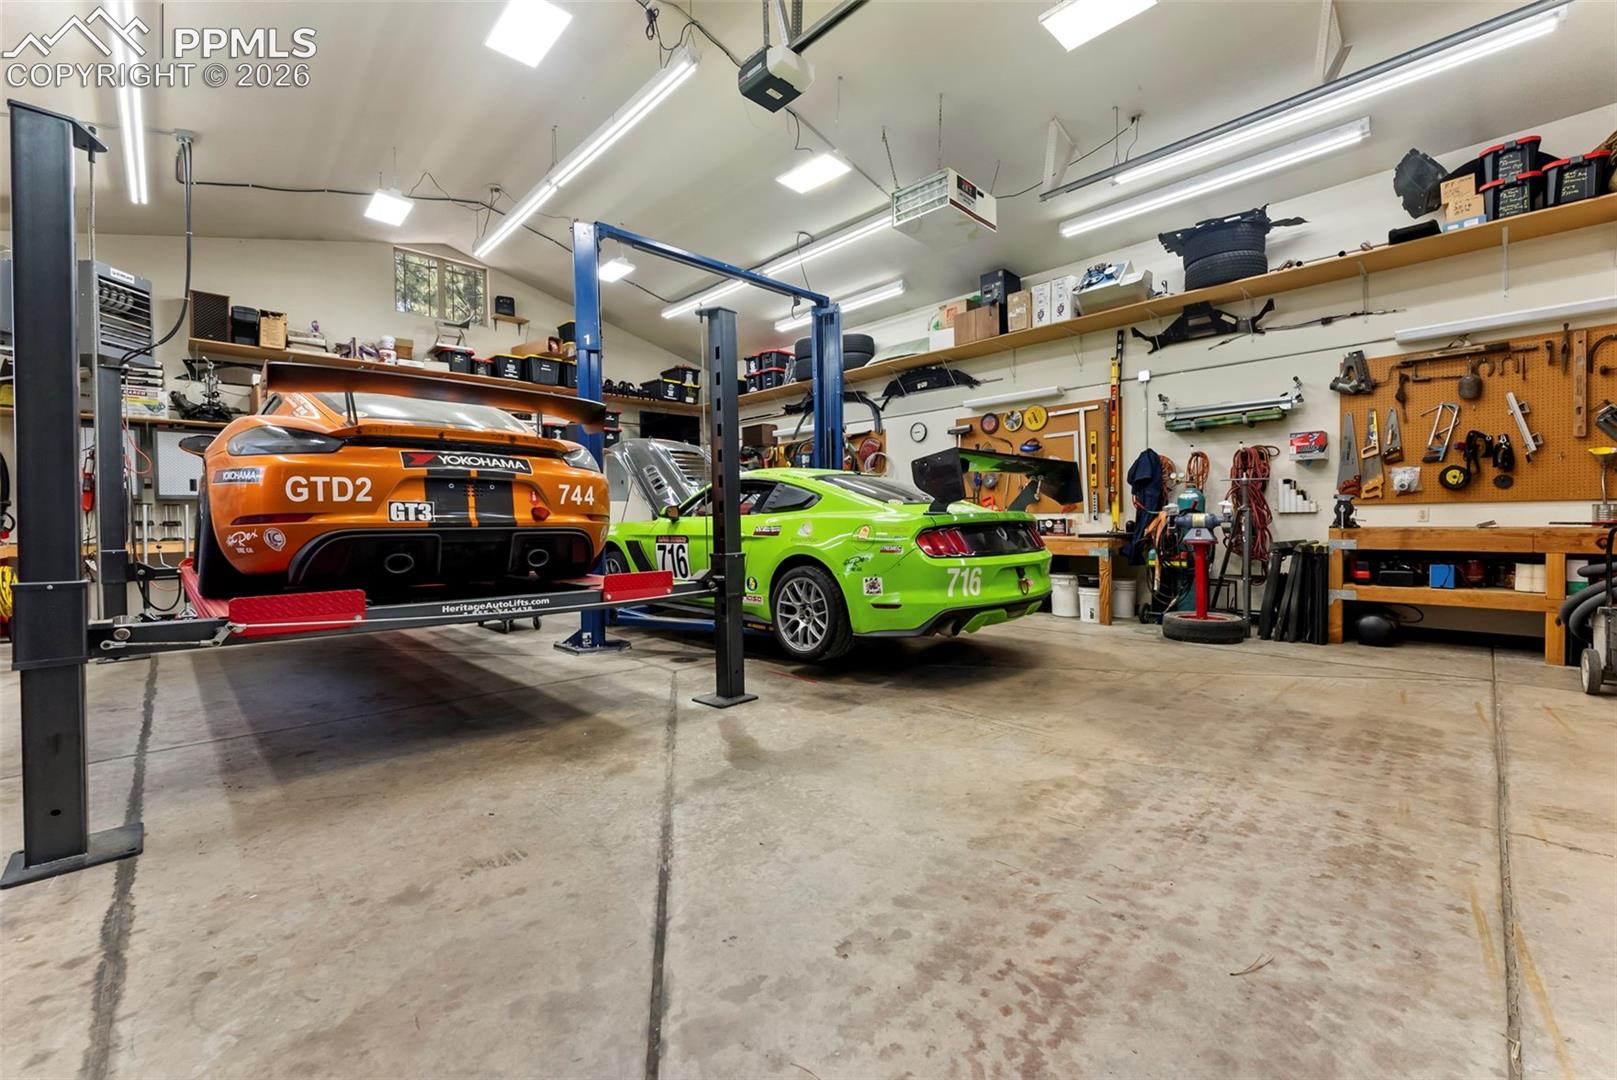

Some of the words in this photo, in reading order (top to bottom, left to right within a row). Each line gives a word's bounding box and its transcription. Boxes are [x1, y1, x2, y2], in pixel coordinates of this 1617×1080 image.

[584, 334, 590, 345] 1
[437, 454, 528, 470] YOKOHAMA
[285, 476, 373, 502] GTD2
[558, 484, 594, 505] 744
[390, 502, 432, 522] GT3
[657, 544, 688, 579] 716
[947, 568, 982, 597] 716
[441, 598, 550, 613] HeritageAutoLifts.com
